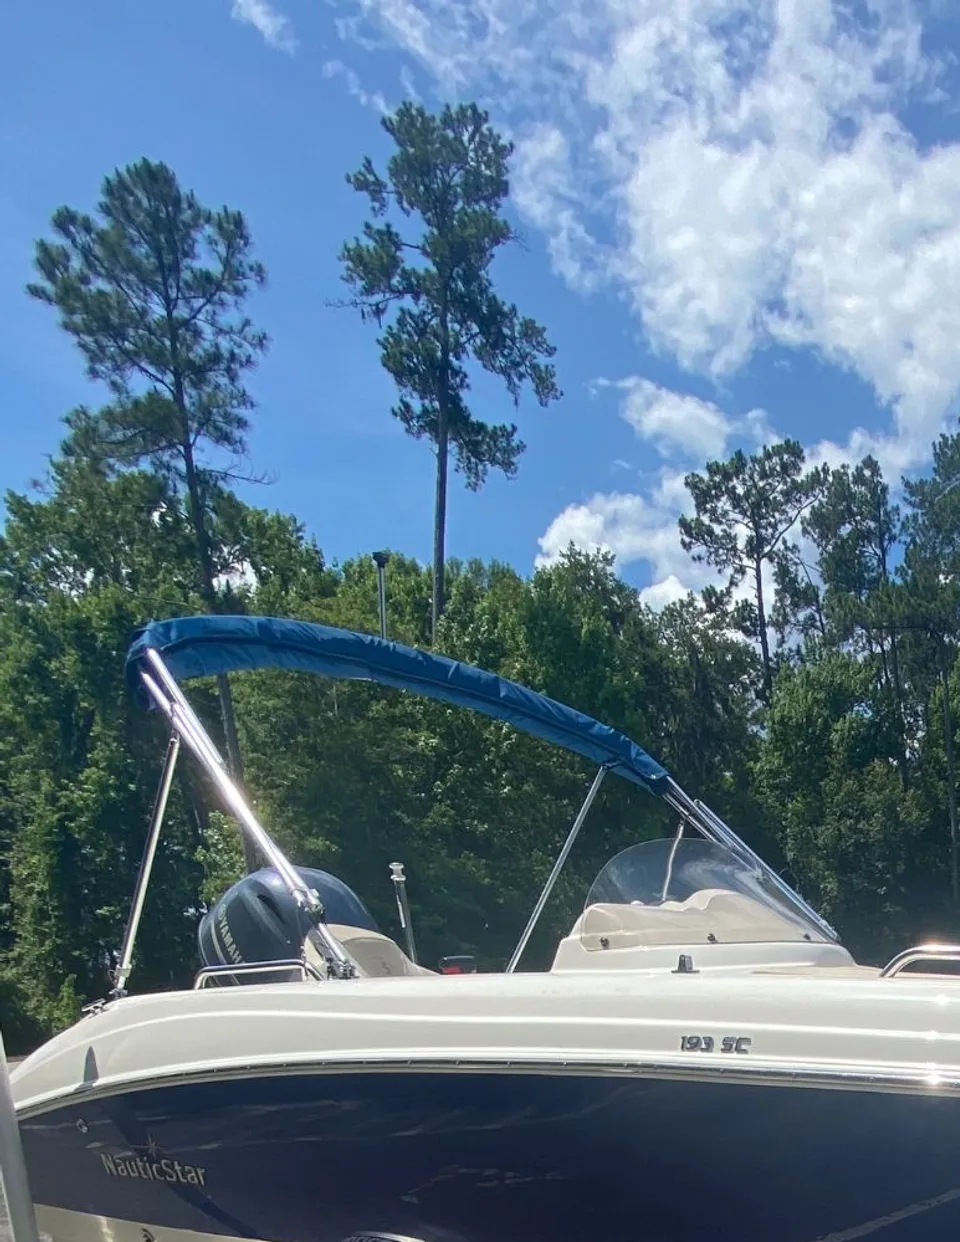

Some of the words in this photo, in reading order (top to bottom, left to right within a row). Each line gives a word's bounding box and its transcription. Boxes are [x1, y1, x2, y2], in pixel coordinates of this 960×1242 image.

[219, 916, 246, 965] YAMAH
[681, 1035, 715, 1053] 193
[720, 1036, 752, 1055] SC
[100, 1152, 205, 1186] NauticStar
